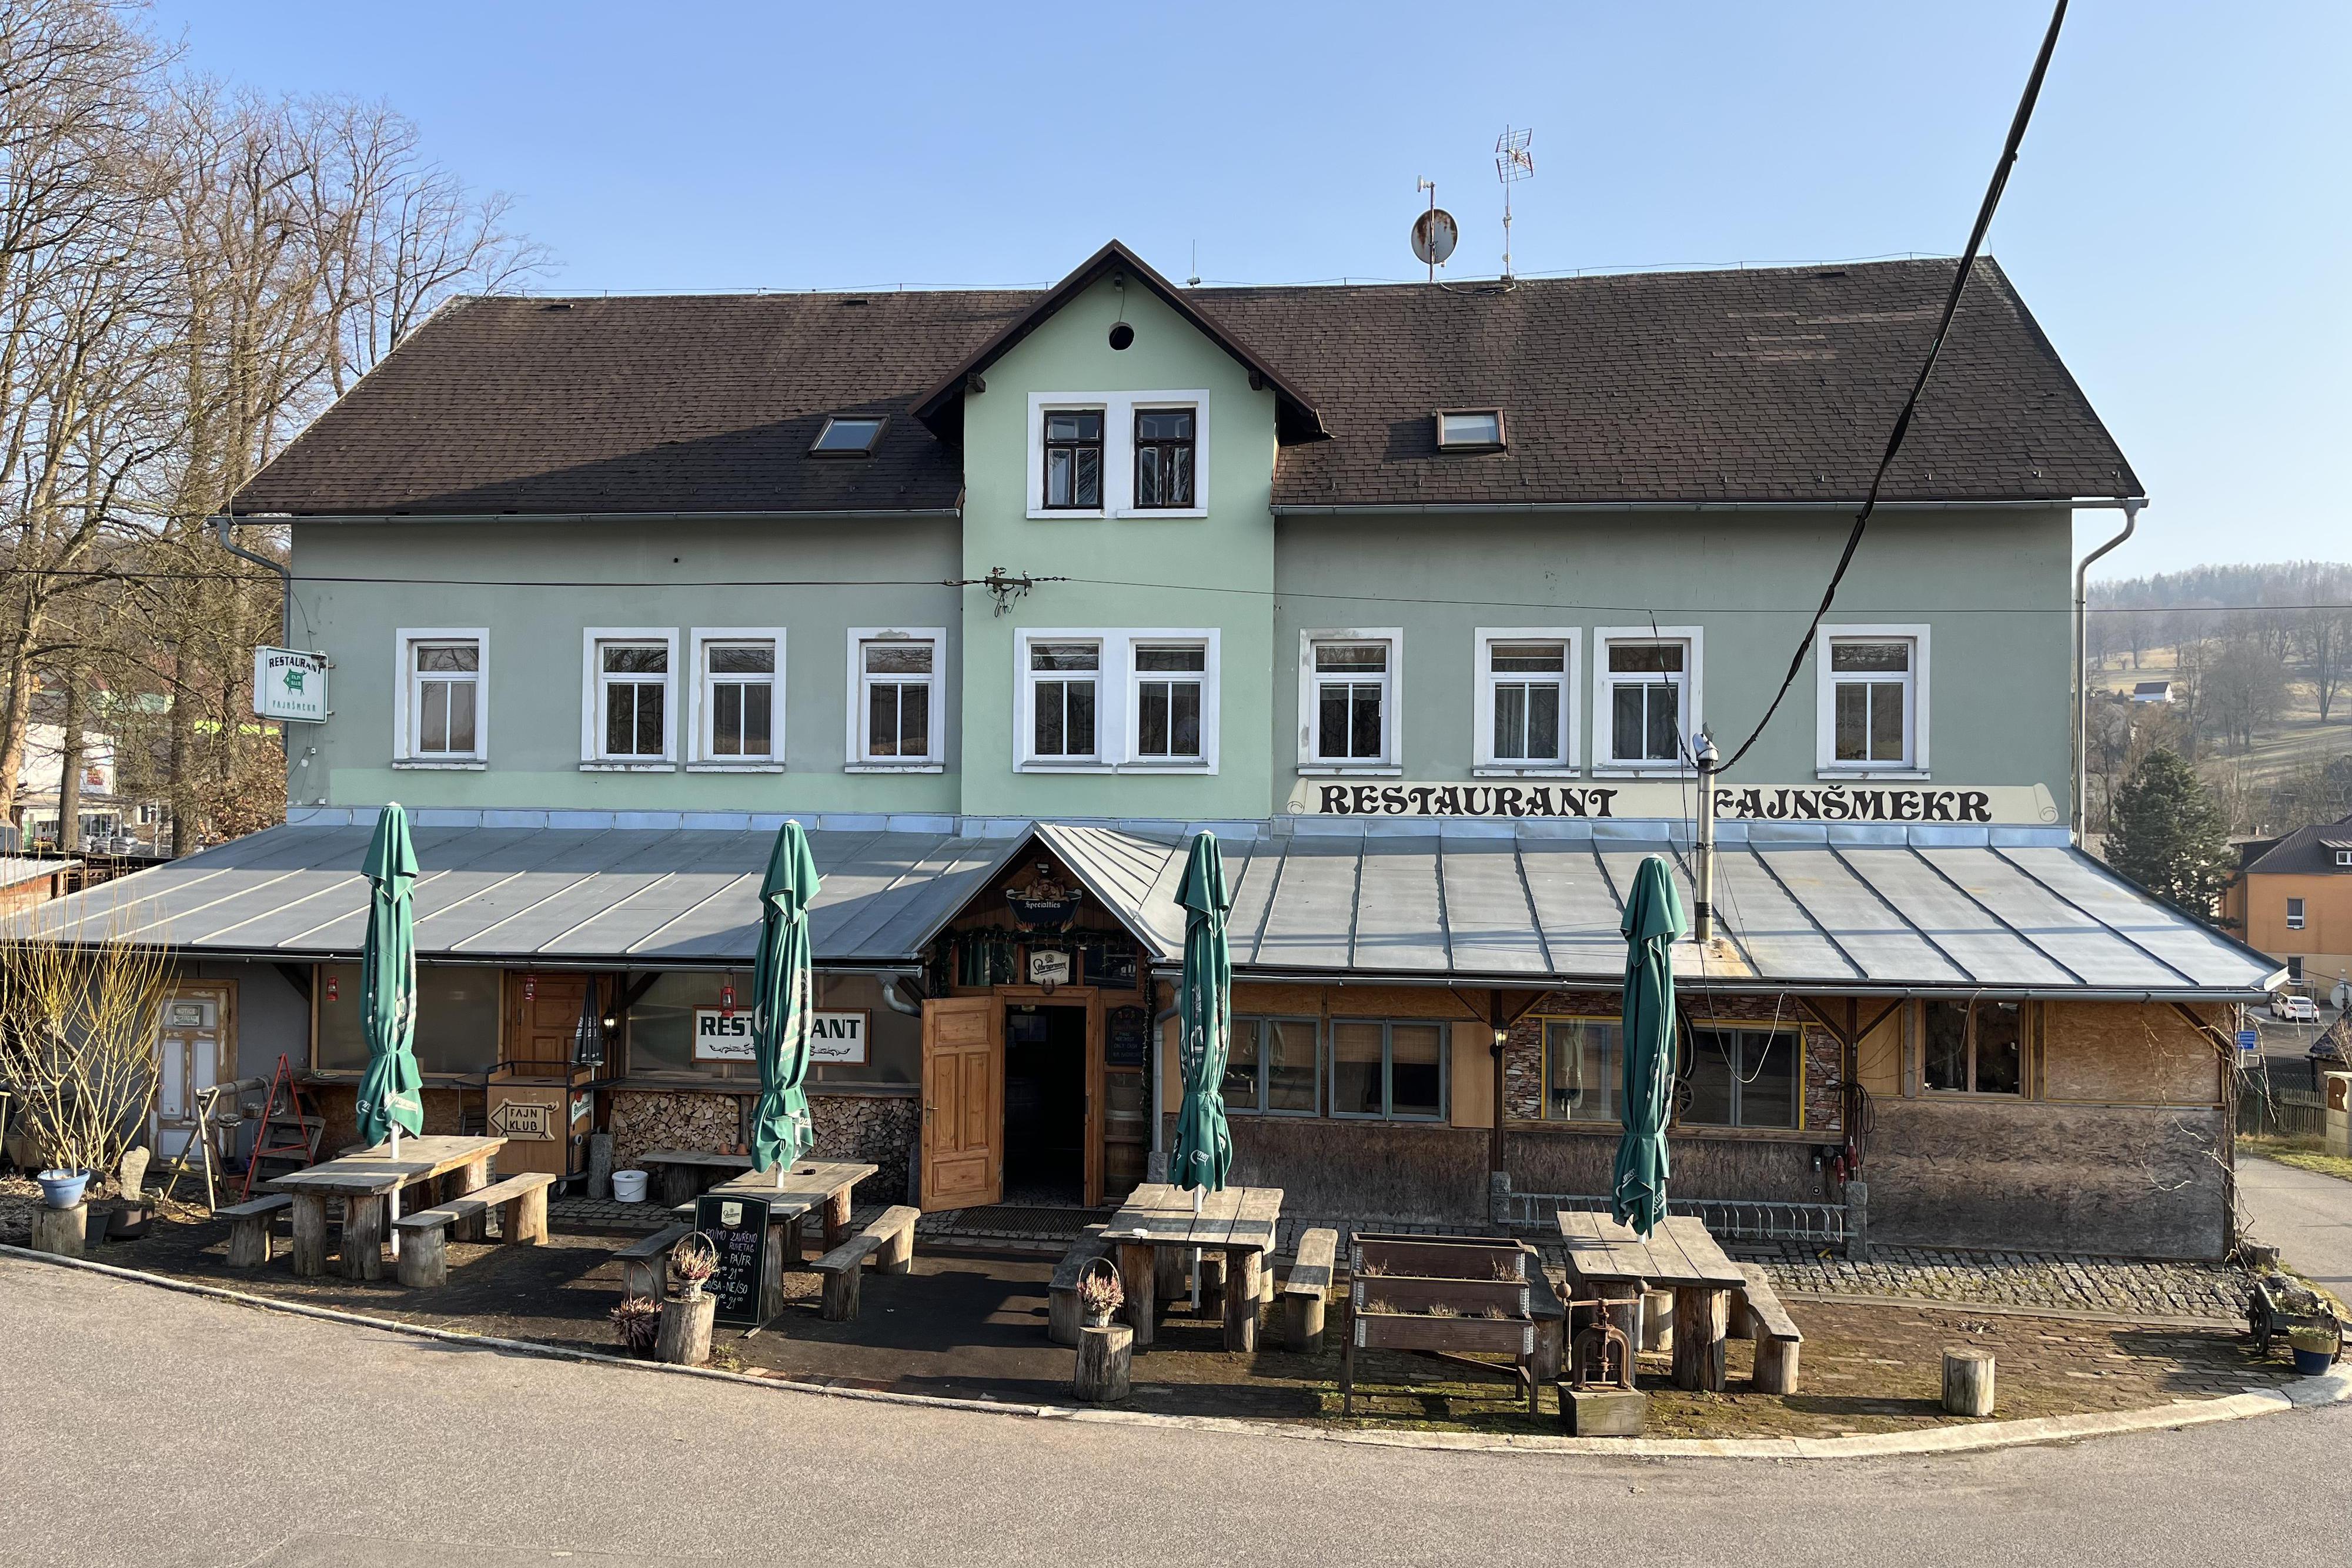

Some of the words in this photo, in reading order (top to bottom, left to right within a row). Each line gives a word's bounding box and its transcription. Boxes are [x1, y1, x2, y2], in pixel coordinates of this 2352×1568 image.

[269, 656, 322, 674] RESTAURANT
[1318, 785, 1618, 817] RESTAURANT
[1713, 785, 1992, 822] FAJNŠMEKR
[700, 1016, 860, 1039] RESANT
[510, 1108, 537, 1118] FAJN
[509, 1120, 537, 1131] KLUB
[730, 1231, 757, 1243] ZAVŘENO
[729, 1242, 754, 1252] RUHETAG
[730, 1252, 751, 1266] PÁ/FR
